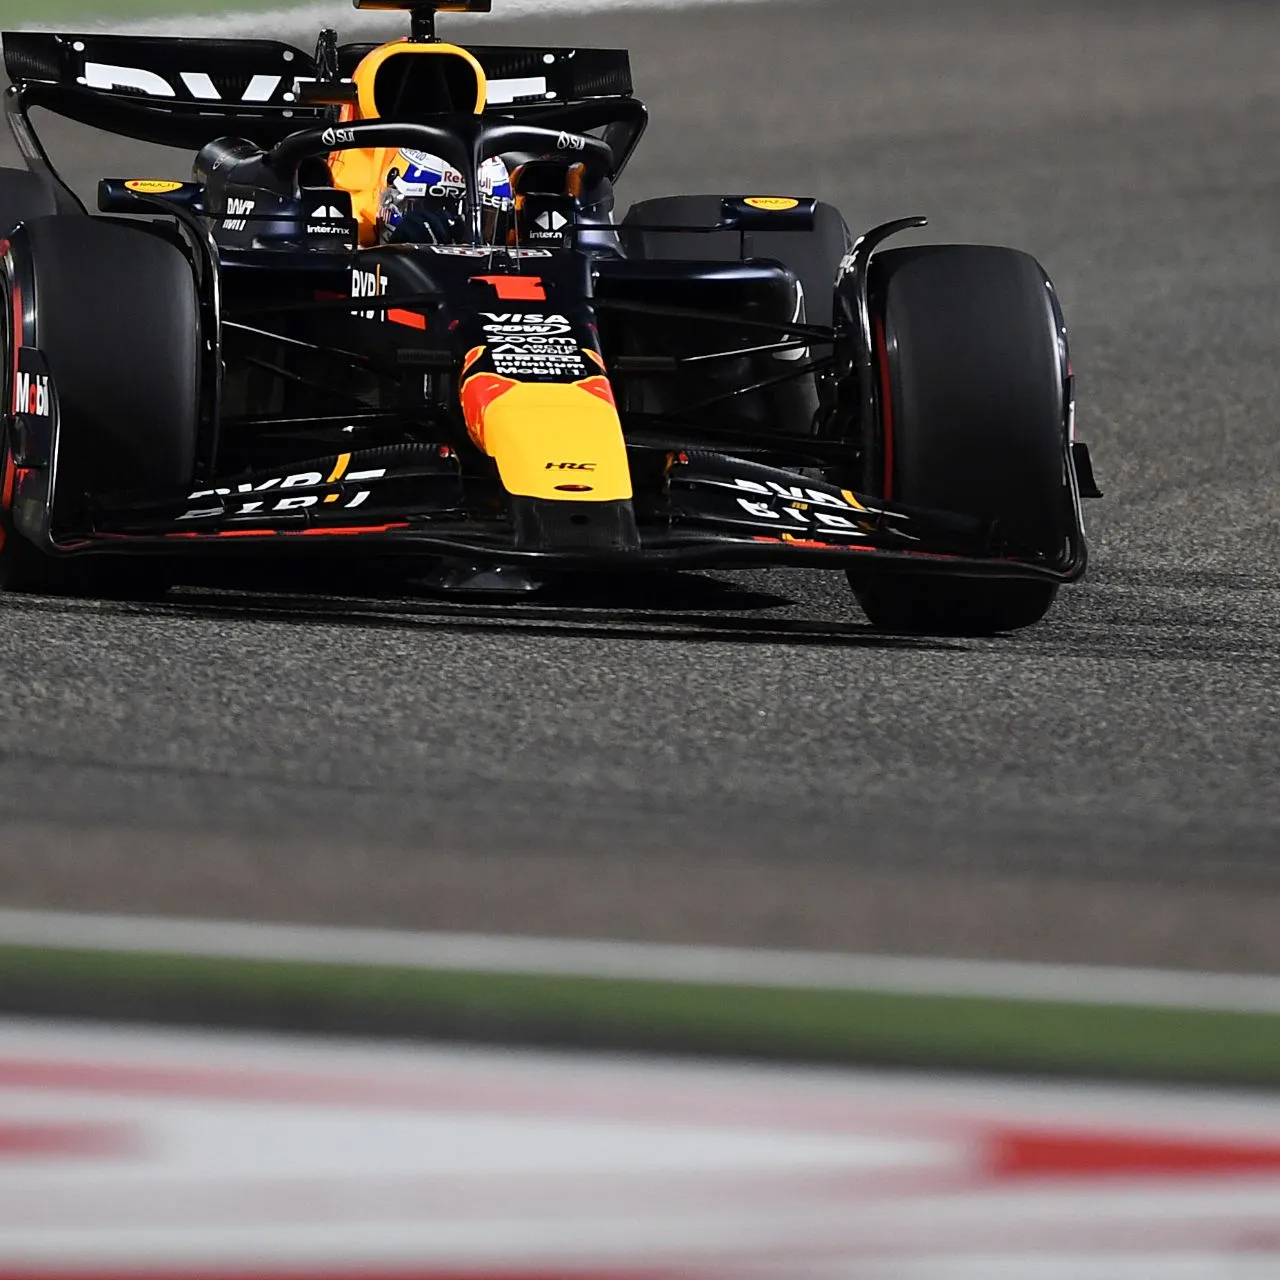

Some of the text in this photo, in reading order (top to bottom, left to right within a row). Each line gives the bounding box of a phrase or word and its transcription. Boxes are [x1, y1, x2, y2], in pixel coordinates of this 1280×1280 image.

[478, 312, 570, 324] VISA
[496, 366, 562, 375] Mobil
[544, 462, 597, 472] HRC
